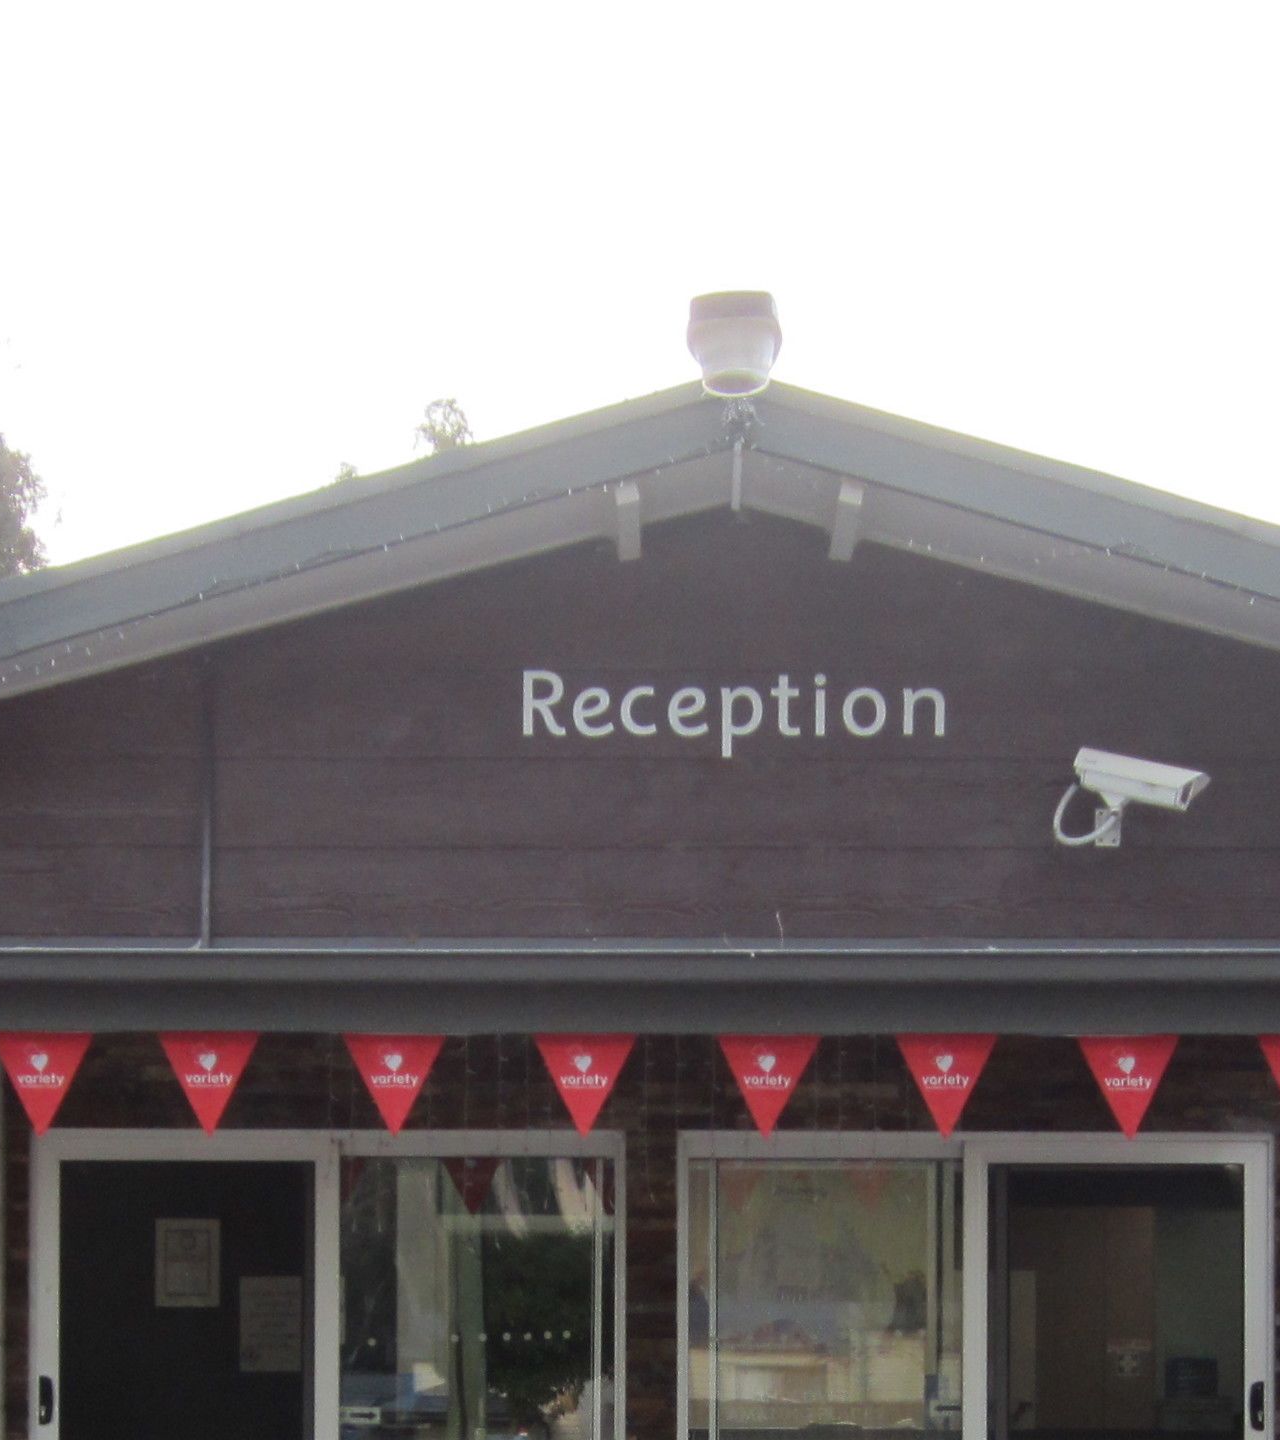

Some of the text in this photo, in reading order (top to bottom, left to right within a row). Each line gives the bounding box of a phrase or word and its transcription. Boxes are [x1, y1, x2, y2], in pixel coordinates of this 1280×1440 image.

[521, 668, 947, 759] Reception
[17, 1072, 65, 1085] variety
[185, 1072, 233, 1085] variety
[370, 1073, 419, 1086] variety
[560, 1074, 608, 1087] variety
[743, 1075, 791, 1087] variety
[922, 1074, 969, 1087] variety
[1104, 1075, 1152, 1088] variety
